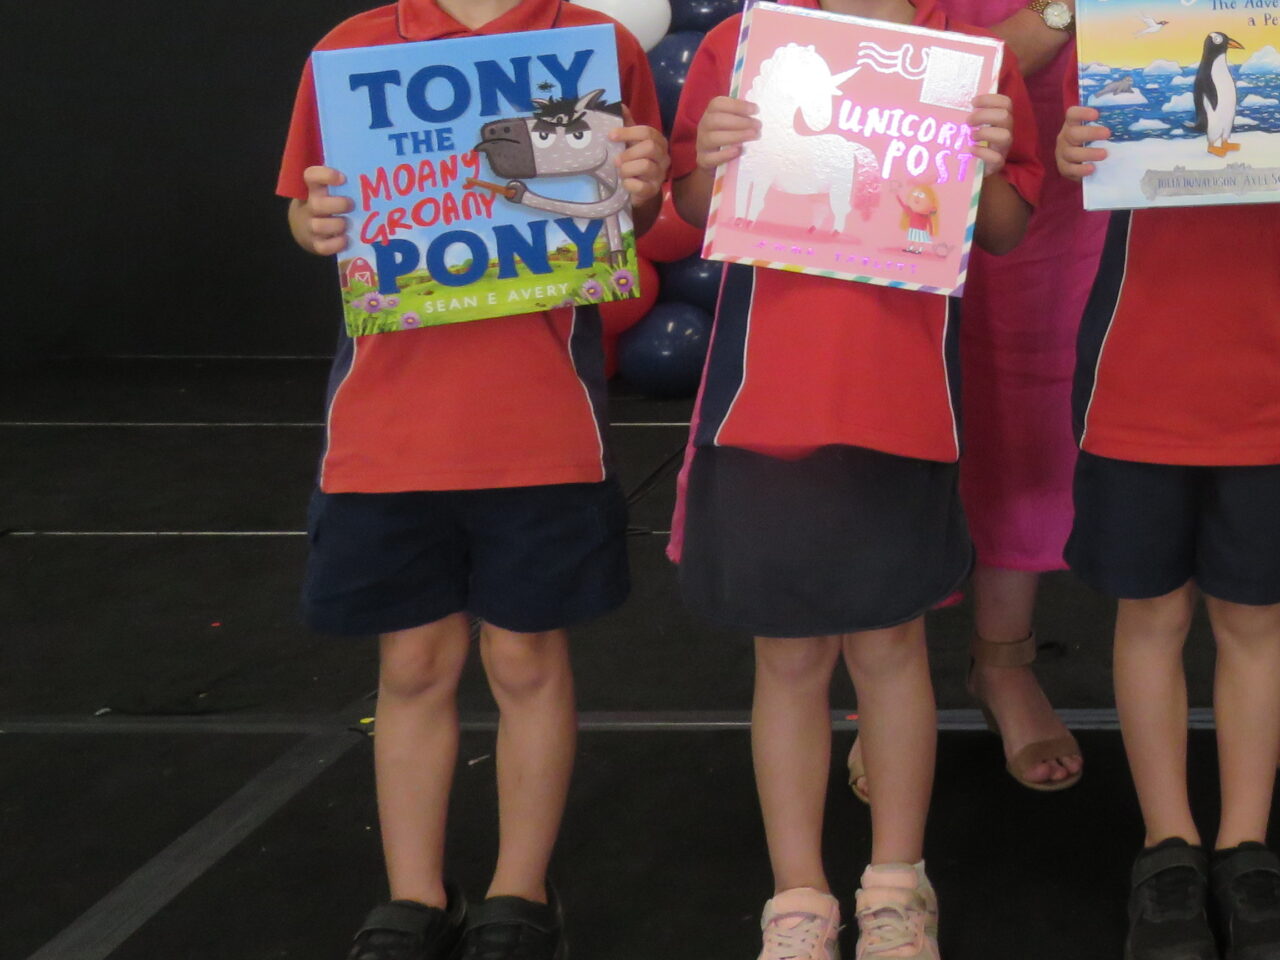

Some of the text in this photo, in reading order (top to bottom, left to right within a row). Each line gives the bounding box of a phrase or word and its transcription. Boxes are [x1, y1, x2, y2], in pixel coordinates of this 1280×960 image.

[1248, 17, 1256, 27] a
[349, 49, 595, 130] TONY
[388, 127, 455, 156] THE
[882, 138, 974, 185] POST
[359, 149, 481, 212] MOANY
[360, 192, 497, 246] GROANY
[370, 217, 605, 296] PONY
[425, 283, 569, 314] SEAN E AVERY
